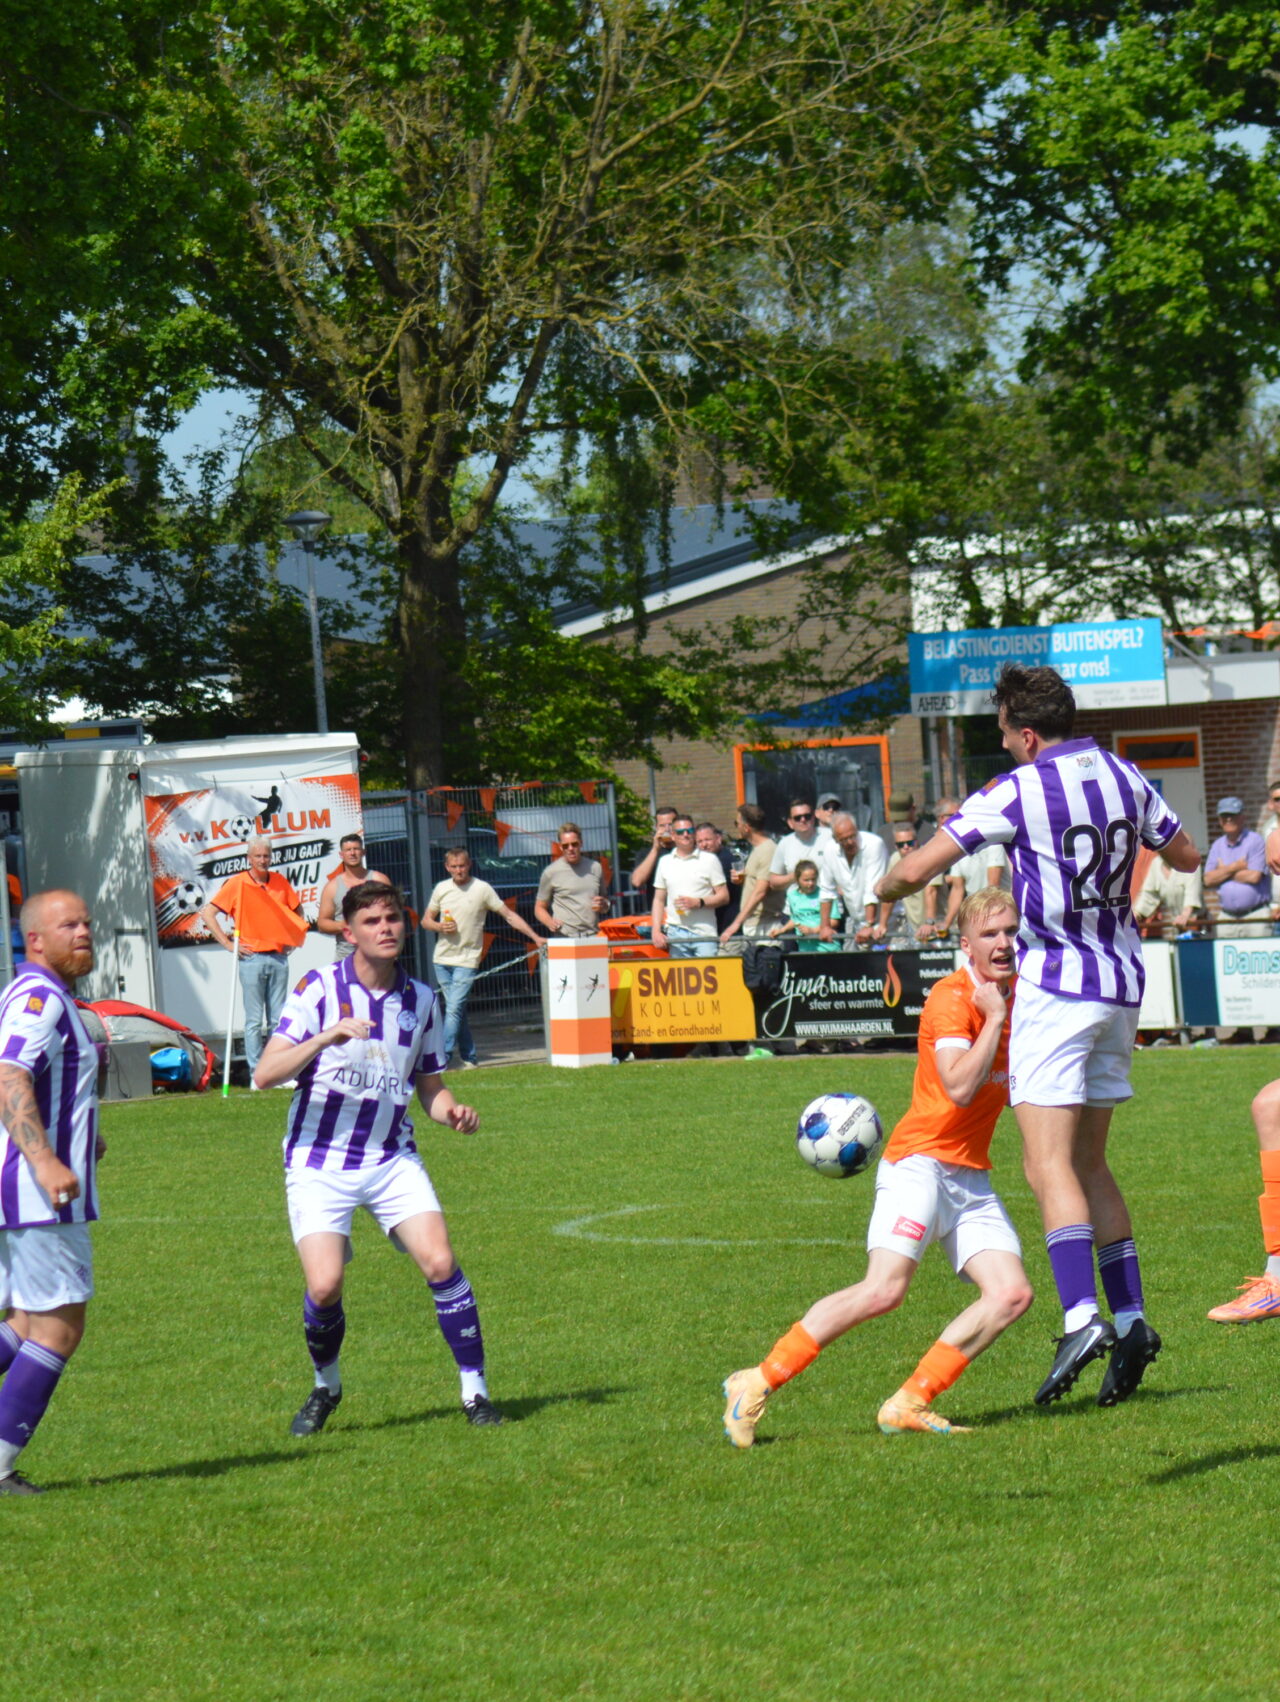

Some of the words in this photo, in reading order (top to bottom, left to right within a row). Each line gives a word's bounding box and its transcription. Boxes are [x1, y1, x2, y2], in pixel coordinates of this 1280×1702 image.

[923, 634, 1049, 661] BELASTINGDIENST
[1051, 627, 1145, 653] BUITENSPEL?
[960, 662, 991, 684] Pass
[1079, 655, 1111, 678] ons!
[211, 808, 332, 842] KOLLUM
[283, 847, 297, 862] JIJ
[299, 843, 324, 859] GAAT
[286, 861, 321, 887] WIJ
[1062, 819, 1136, 912] 22
[637, 965, 719, 997] SMIDS
[829, 974, 884, 993] haarden
[640, 1000, 721, 1018] KOLLUM
[809, 998, 831, 1012] sfeer
[833, 1000, 845, 1010] en
[848, 997, 884, 1009] warmte
[629, 1026, 655, 1038] Zand-
[657, 1028, 667, 1037] en
[669, 1023, 722, 1037] Grondhandel
